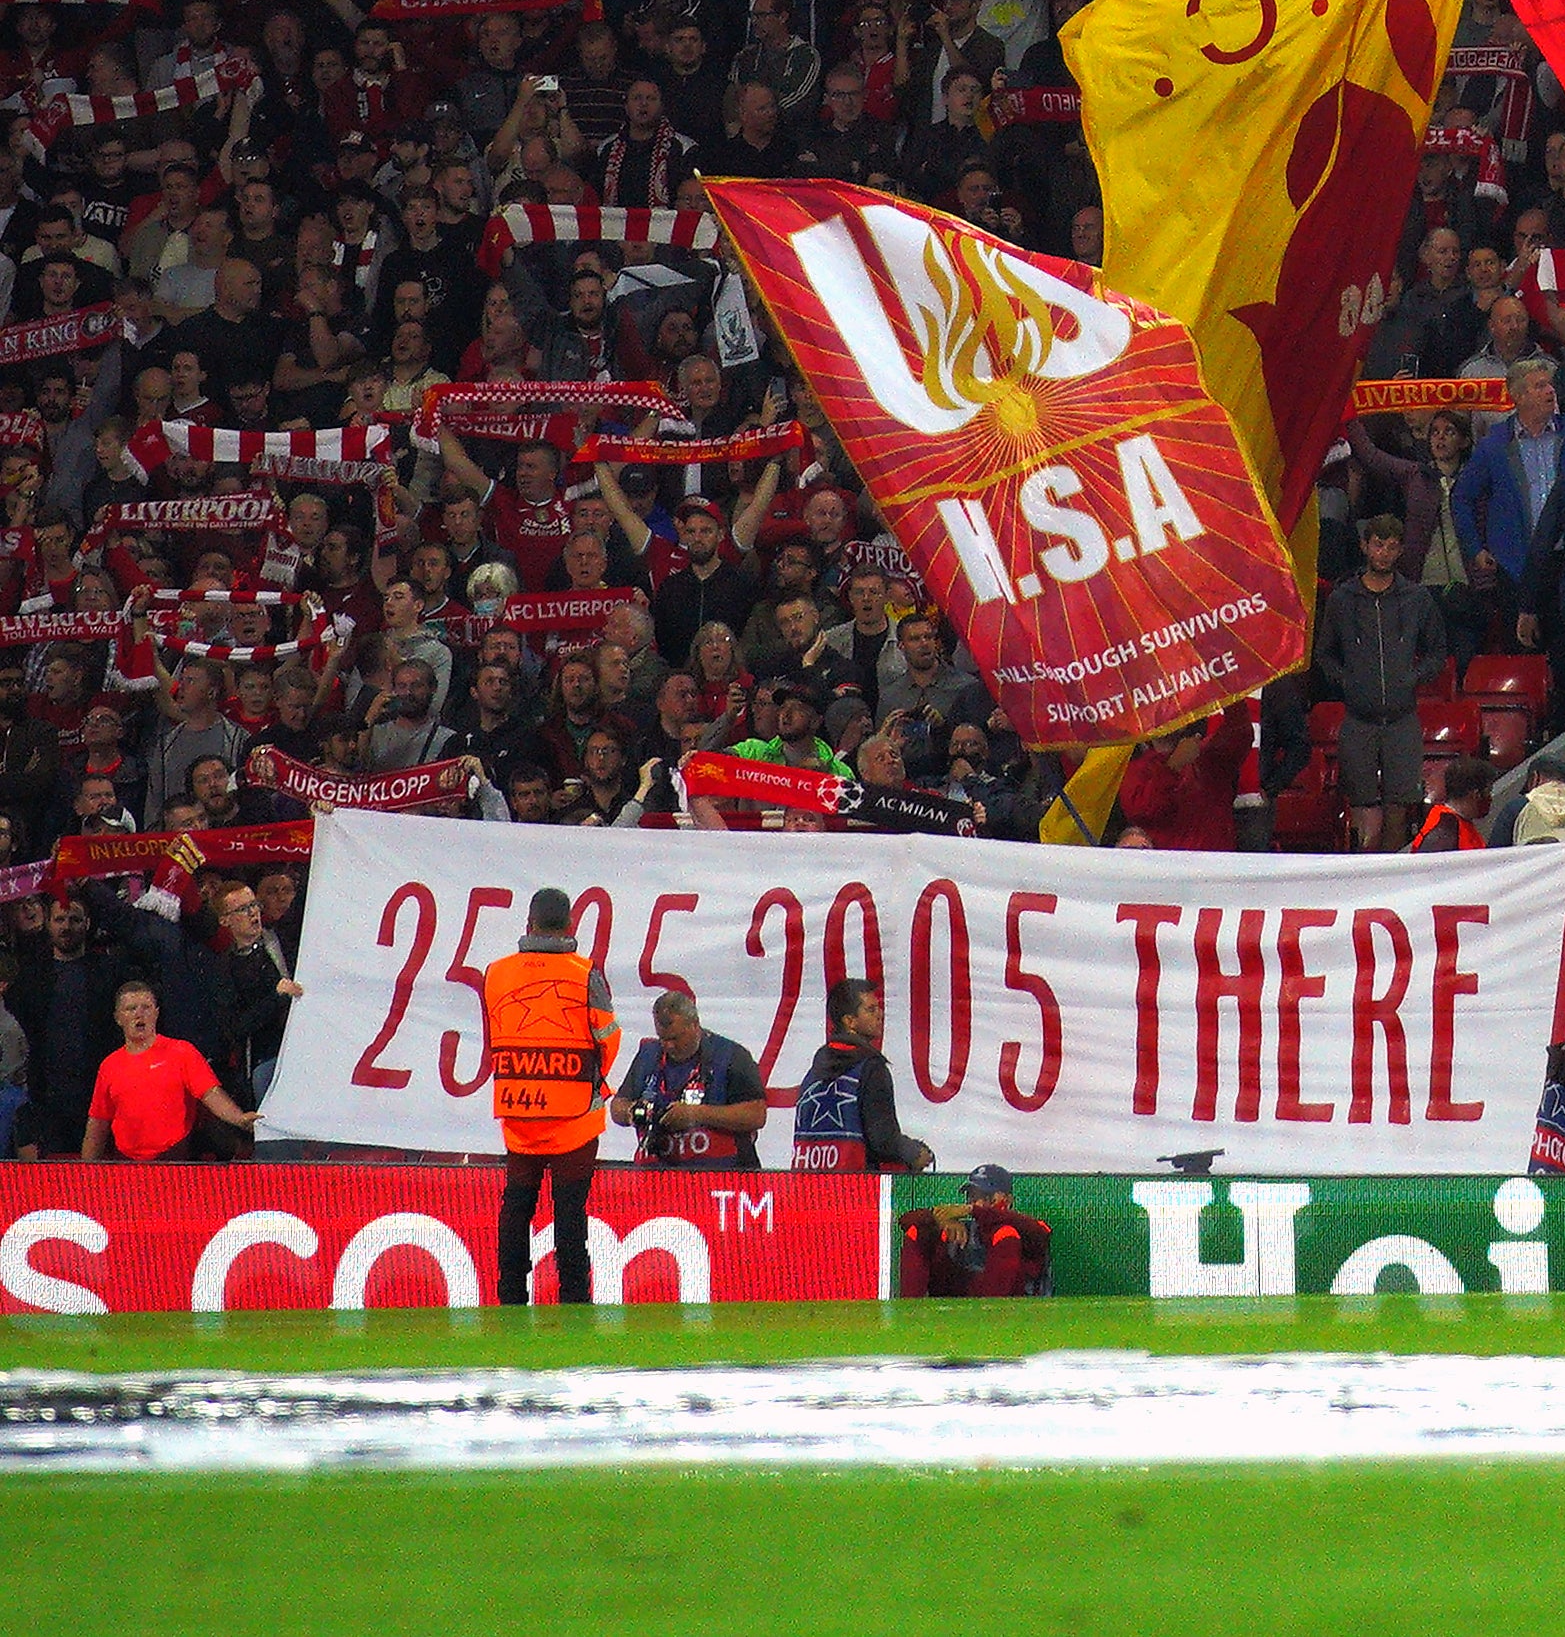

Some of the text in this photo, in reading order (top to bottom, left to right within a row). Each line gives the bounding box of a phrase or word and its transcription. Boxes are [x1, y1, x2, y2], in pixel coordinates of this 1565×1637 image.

[26, 323, 79, 350] KING
[1352, 380, 1494, 410] LIVERPOOL
[120, 497, 274, 522] LIVERPOOL
[2, 622, 120, 641] YOU'LL NEVER WALK
[1140, 592, 1269, 653] SURVIVORS
[1132, 650, 1240, 711] ALLIANCE
[735, 769, 949, 824] LIVERPOOL FC AC MILAN
[1116, 903, 1490, 1124] THERE
[500, 1086, 549, 1111] 444
